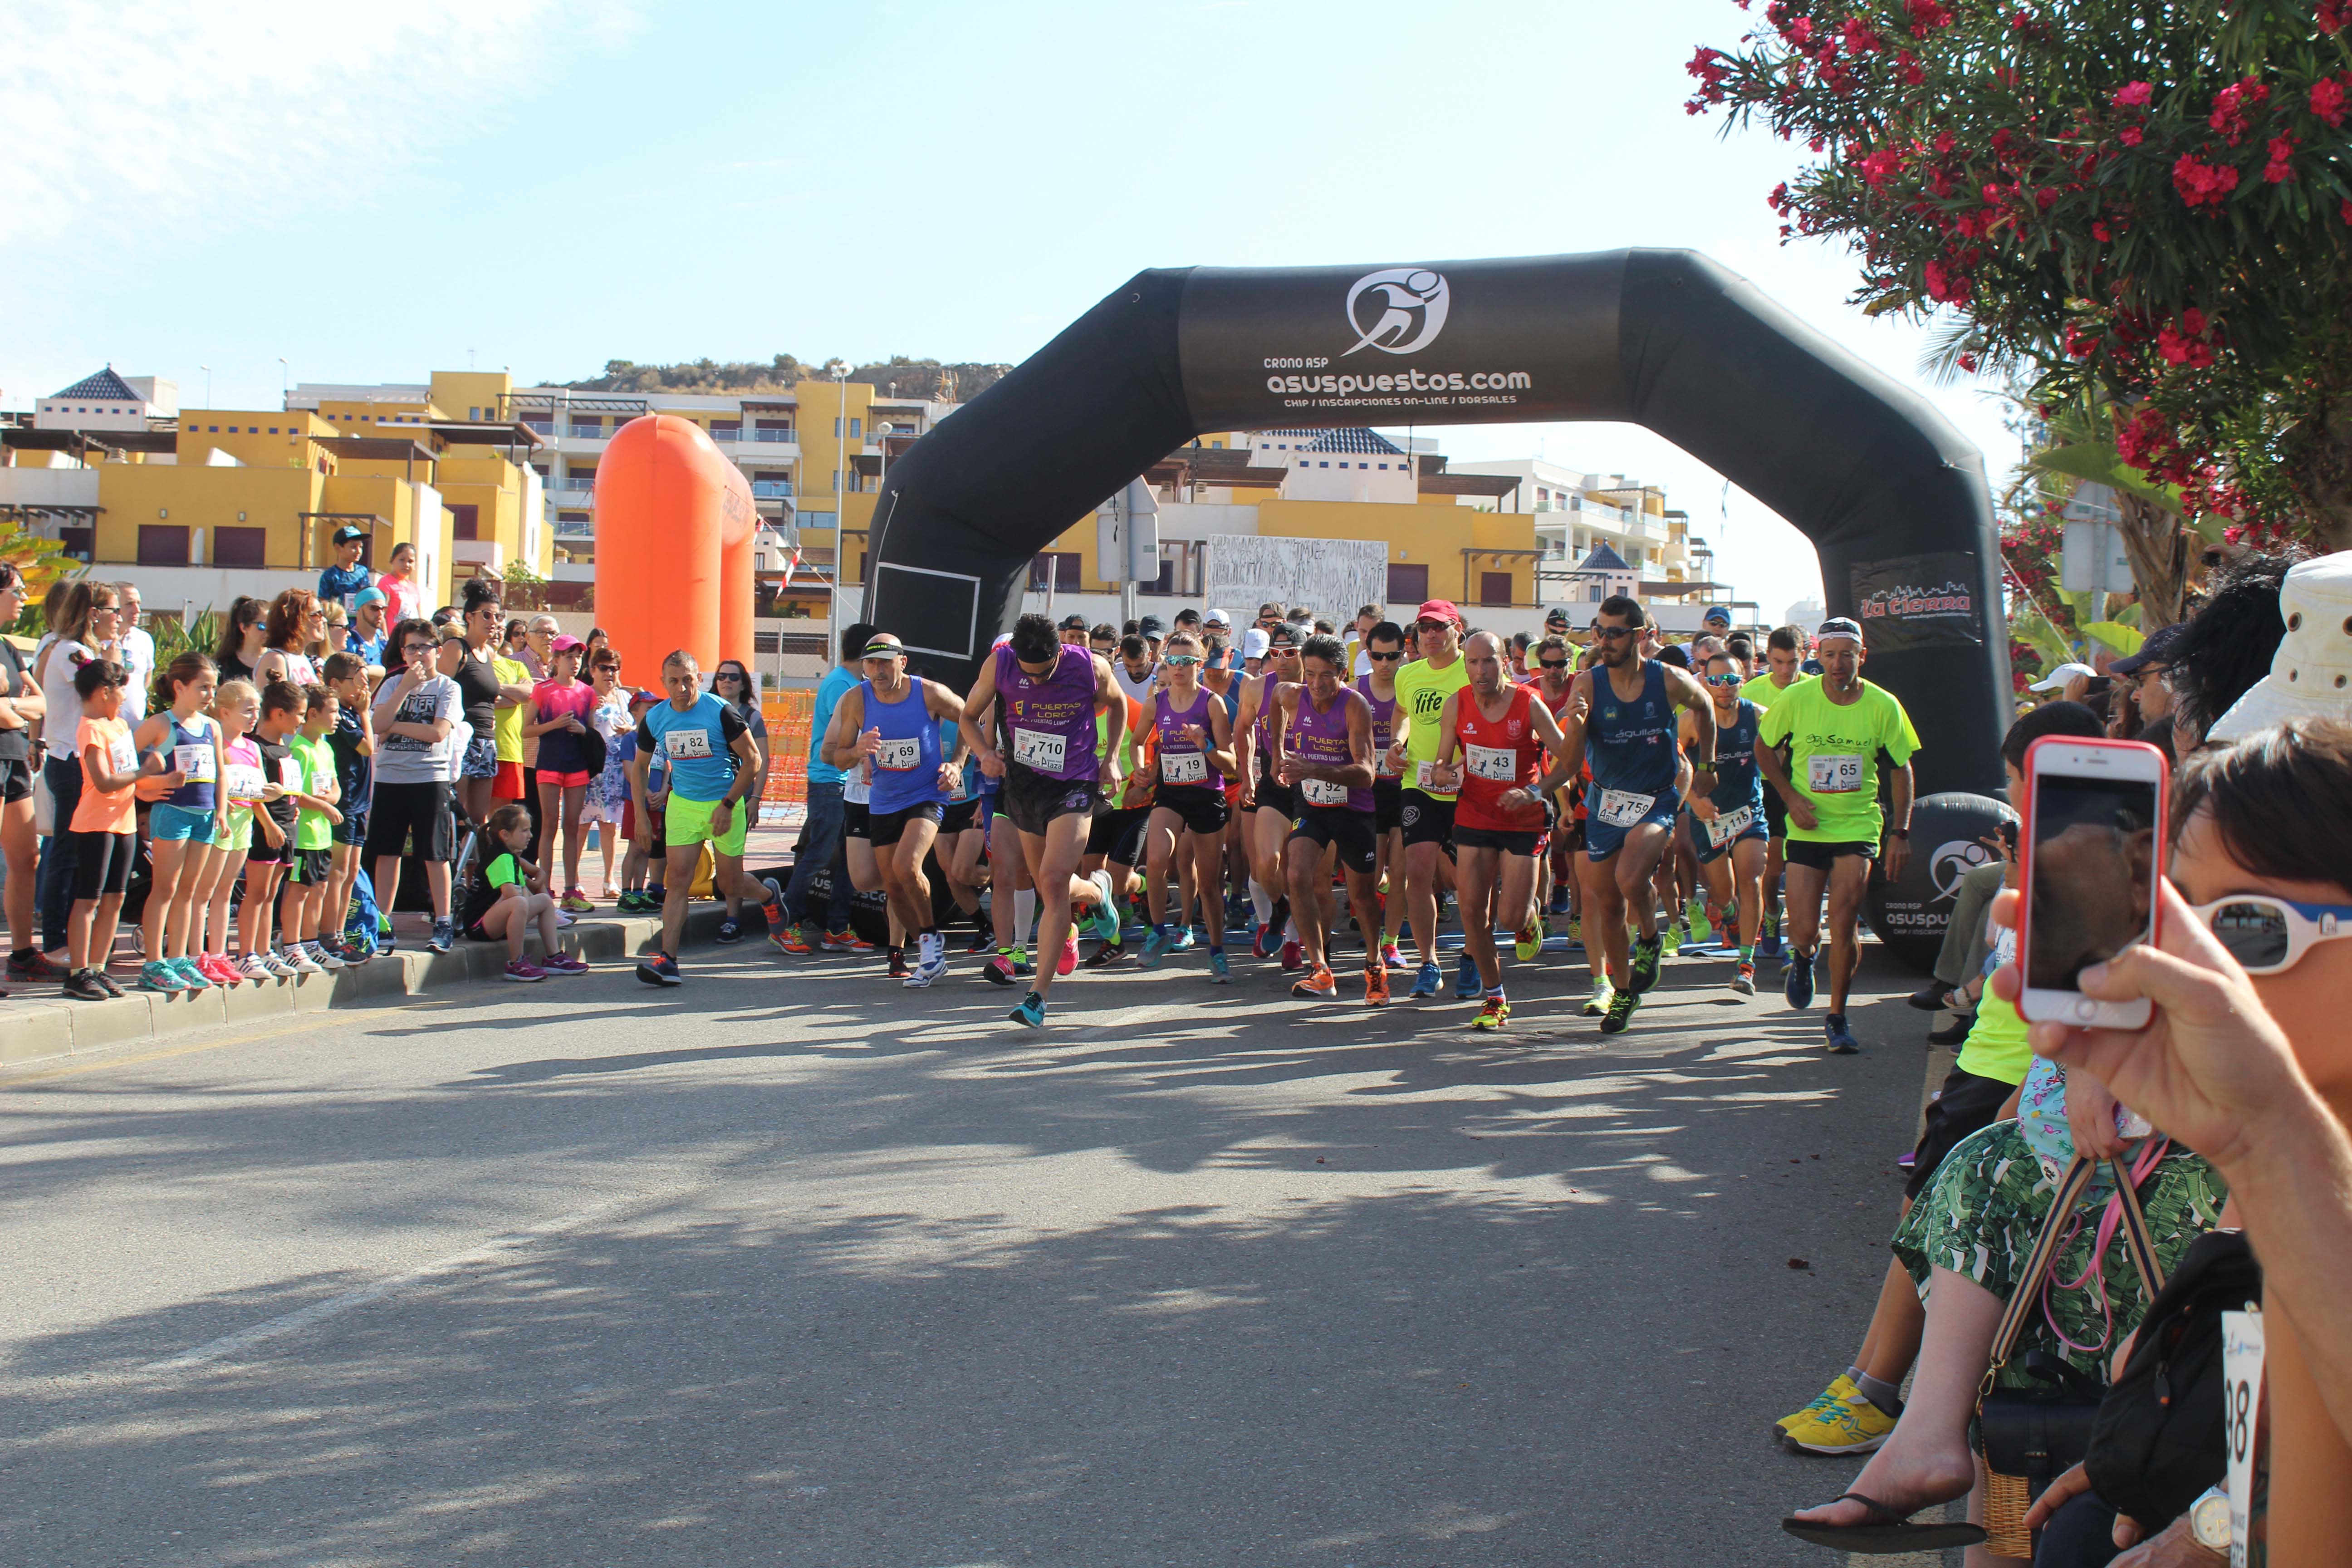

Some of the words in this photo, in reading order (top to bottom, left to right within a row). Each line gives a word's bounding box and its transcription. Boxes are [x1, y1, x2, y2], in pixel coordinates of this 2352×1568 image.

[1264, 358, 1303, 368] CRONO
[1305, 358, 1328, 368] ASP
[1267, 368, 1531, 397] asuspuestos.com
[1318, 398, 1401, 407] INSCRIPCIONES
[1403, 397, 1449, 405] ON-LINE
[1459, 395, 1517, 404] DORSALES
[1032, 702, 1081, 710] PUERTAS
[1416, 691, 1442, 714] life
[689, 737, 703, 747] 82
[1827, 735, 1872, 746] Samuel
[900, 746, 914, 756] 69
[1039, 741, 1062, 755] 710
[1313, 744, 1348, 753] LORCA
[1041, 756, 1062, 769] Plaza
[1186, 760, 1200, 770] 19
[1493, 757, 1509, 768] 43
[1840, 764, 1857, 775] 65
[1493, 770, 1514, 781] Plaza
[1325, 782, 1341, 791] 92
[1326, 794, 1347, 804] Plaza
[1627, 801, 1649, 814] 759
[1887, 913, 1950, 928] asuspu
